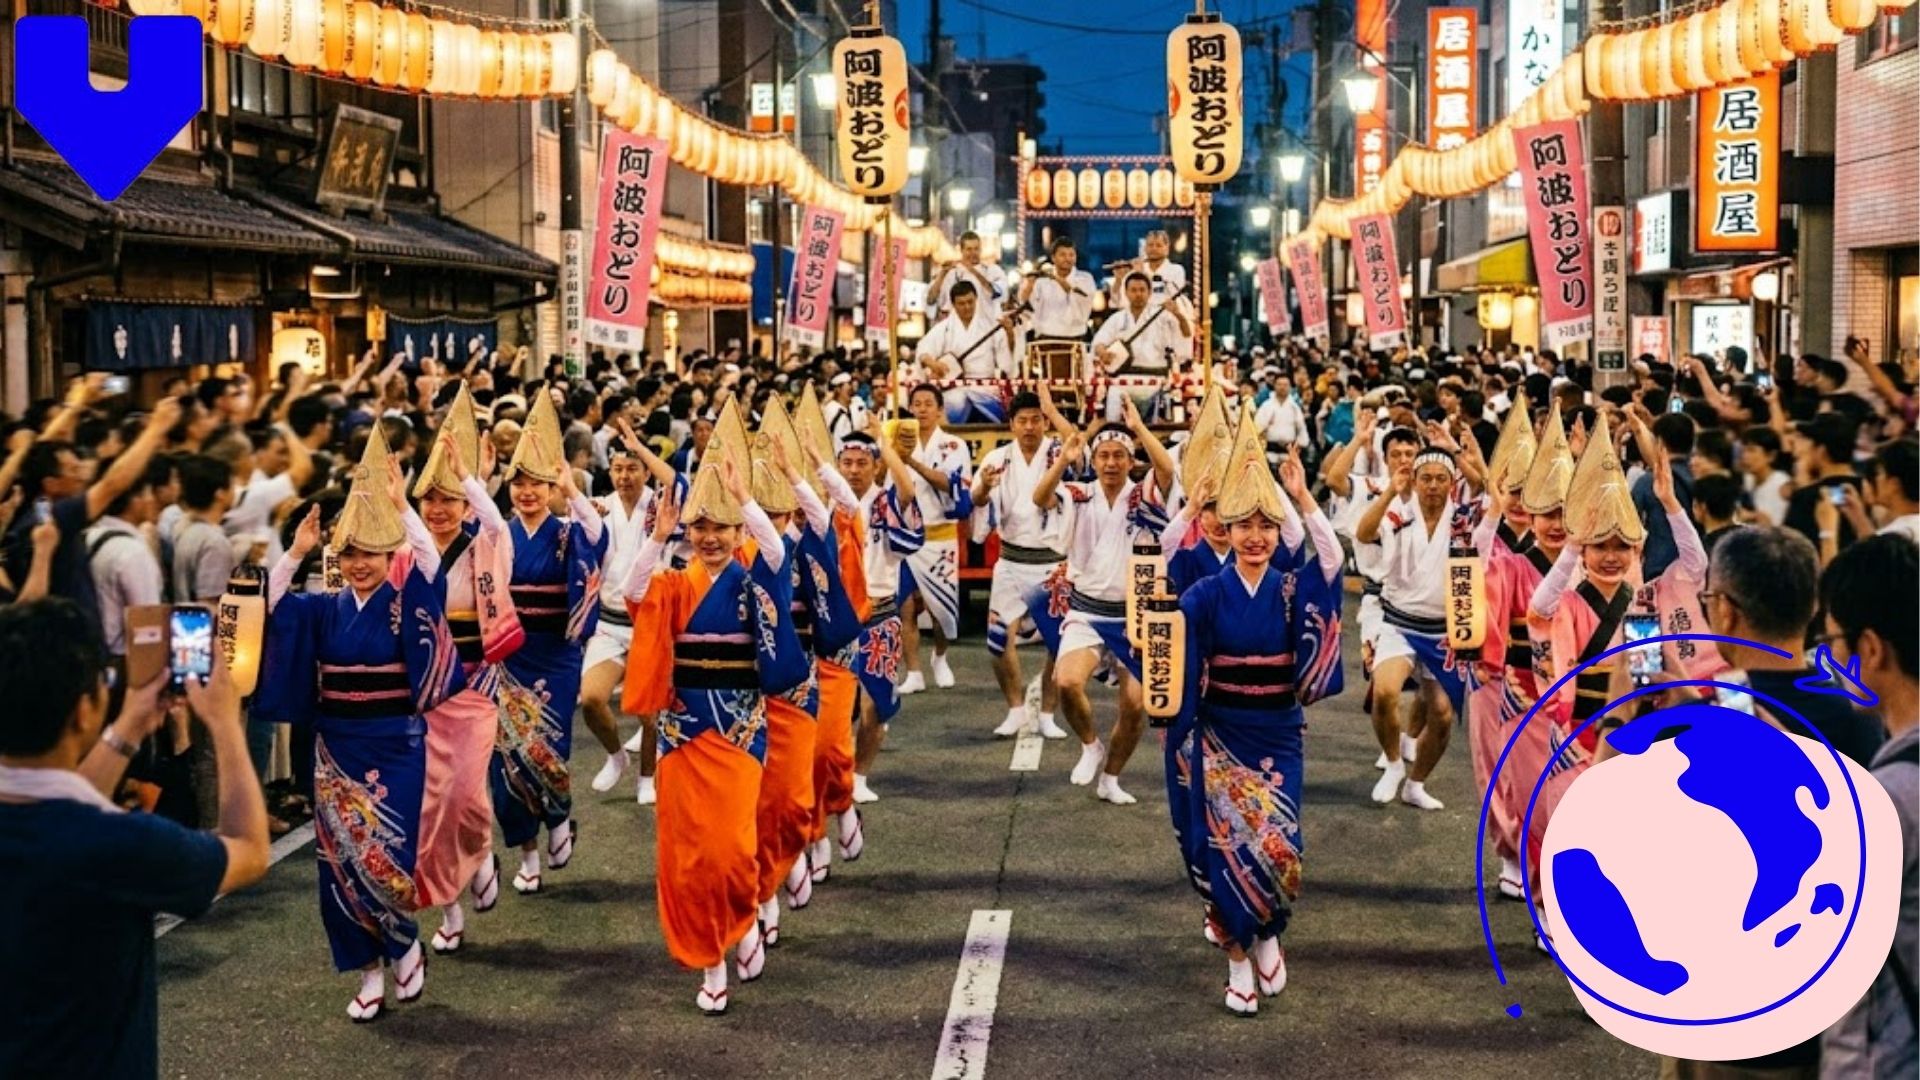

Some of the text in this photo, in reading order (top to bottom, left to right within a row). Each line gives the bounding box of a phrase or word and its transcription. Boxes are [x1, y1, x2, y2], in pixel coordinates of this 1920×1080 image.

[843, 48, 891, 190] 阿波おどり
[1187, 33, 1232, 176] 阿波おどり
[1716, 89, 1759, 234] 居酒屋
[603, 144, 653, 315] 阿波おどり
[1358, 220, 1395, 326] 阿波おどり
[1529, 133, 1587, 309] 阿波おどり
[1147, 622, 1172, 709] 阿波おどり
[1450, 565, 1473, 642] 阿波おどり
